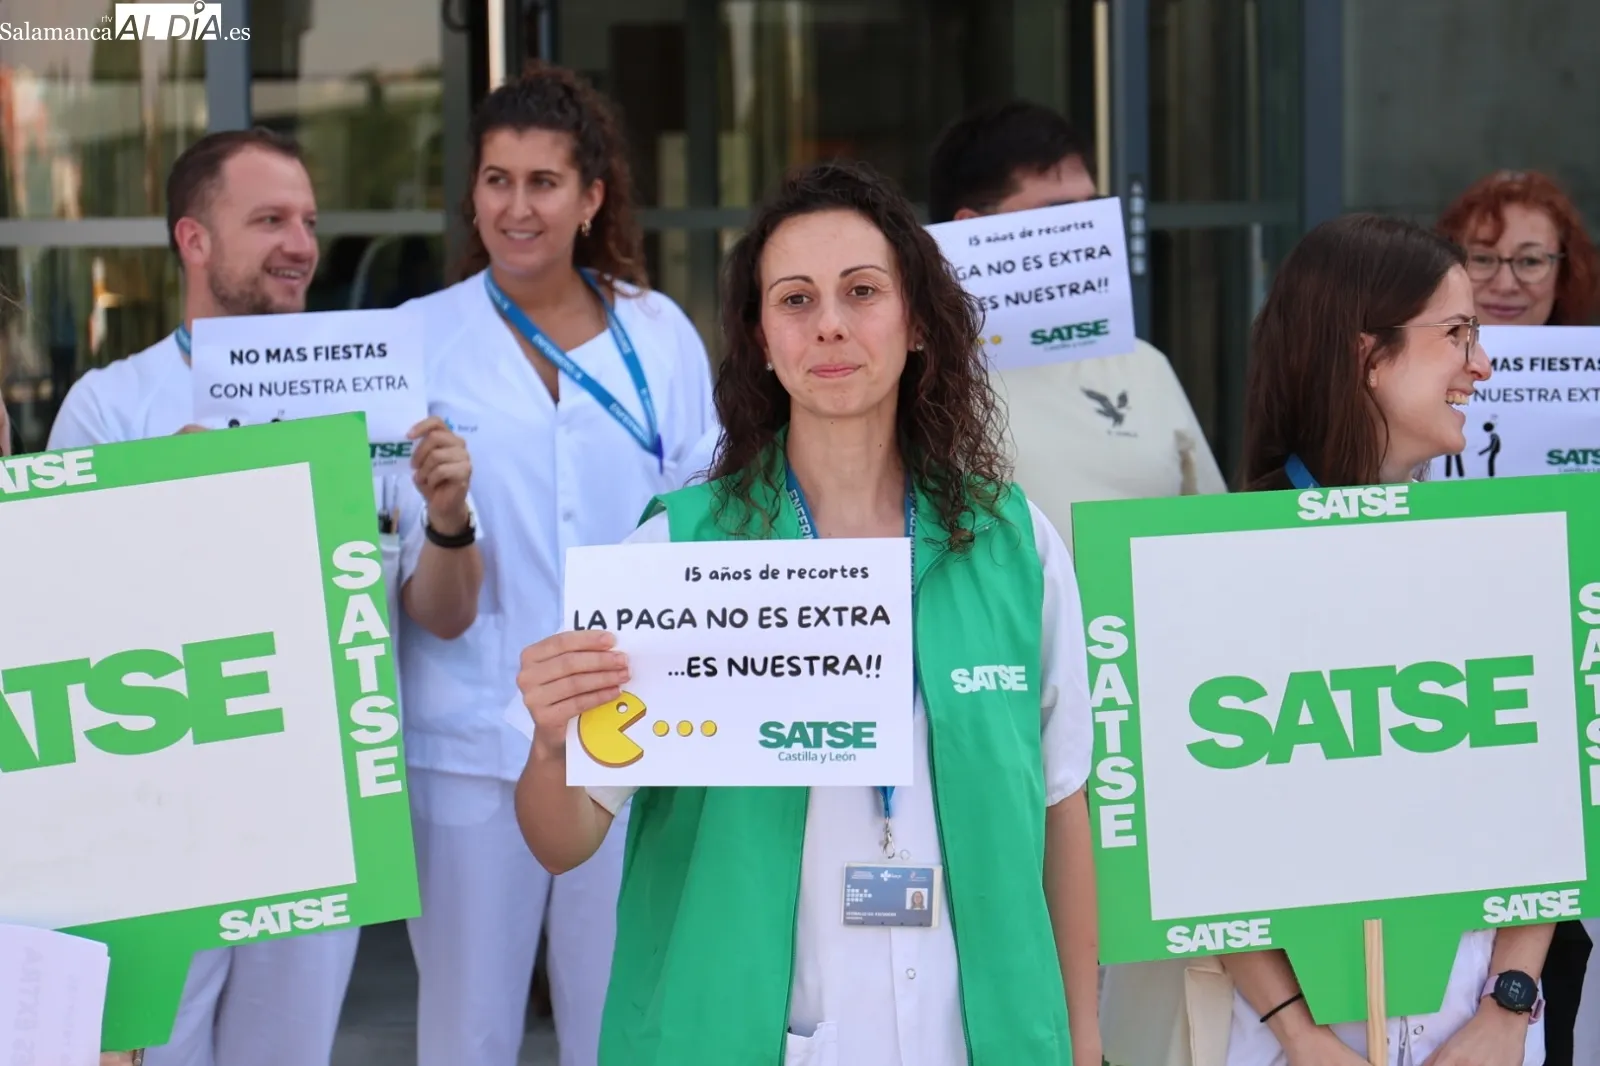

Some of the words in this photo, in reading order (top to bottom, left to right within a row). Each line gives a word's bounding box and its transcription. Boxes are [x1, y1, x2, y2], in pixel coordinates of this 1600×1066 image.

[968, 235, 981, 247] 15
[1019, 225, 1034, 239] de
[956, 264, 982, 282] GA
[987, 259, 1017, 276] NO
[1022, 255, 1043, 272] ES
[1049, 244, 1112, 268] EXTRA
[1004, 277, 1109, 308] NUESTRA!!
[1030, 318, 1110, 345] SATSE
[230, 349, 260, 366] NO
[265, 347, 308, 364] MAS
[313, 342, 388, 362] FIESTAS
[1529, 357, 1600, 372] FIESTA
[209, 383, 253, 399] CON
[259, 378, 347, 397] NUESTRA
[351, 375, 409, 393] EXTRA
[1475, 387, 1562, 402] NUESTRA
[1567, 387, 1600, 402] EXT
[369, 440, 413, 459] TSE
[789, 488, 814, 539] ENFER
[1298, 486, 1410, 521] SATSE
[684, 566, 702, 583] 15
[708, 566, 752, 582] años
[759, 563, 781, 582] de
[786, 564, 870, 581] recortes
[574, 609, 608, 632] LA
[616, 607, 698, 632] PAGA
[706, 606, 749, 630] NO
[757, 606, 789, 630] ES
[798, 604, 891, 629] EXTRA
[331, 540, 403, 798] SATSE
[668, 655, 718, 679] ...ES
[727, 654, 882, 679] NUESTRA!!
[950, 664, 1028, 694] SATSE
[1186, 655, 1539, 770] SATSE
[758, 721, 877, 749] SATSE
[1087, 615, 1137, 849] SATSE
[777, 750, 818, 763] Castilla
[820, 753, 827, 765] y
[829, 751, 857, 762] León
[218, 893, 350, 941] SATSE
[1482, 888, 1581, 925] SATSE
[1166, 918, 1272, 954] SATSE
